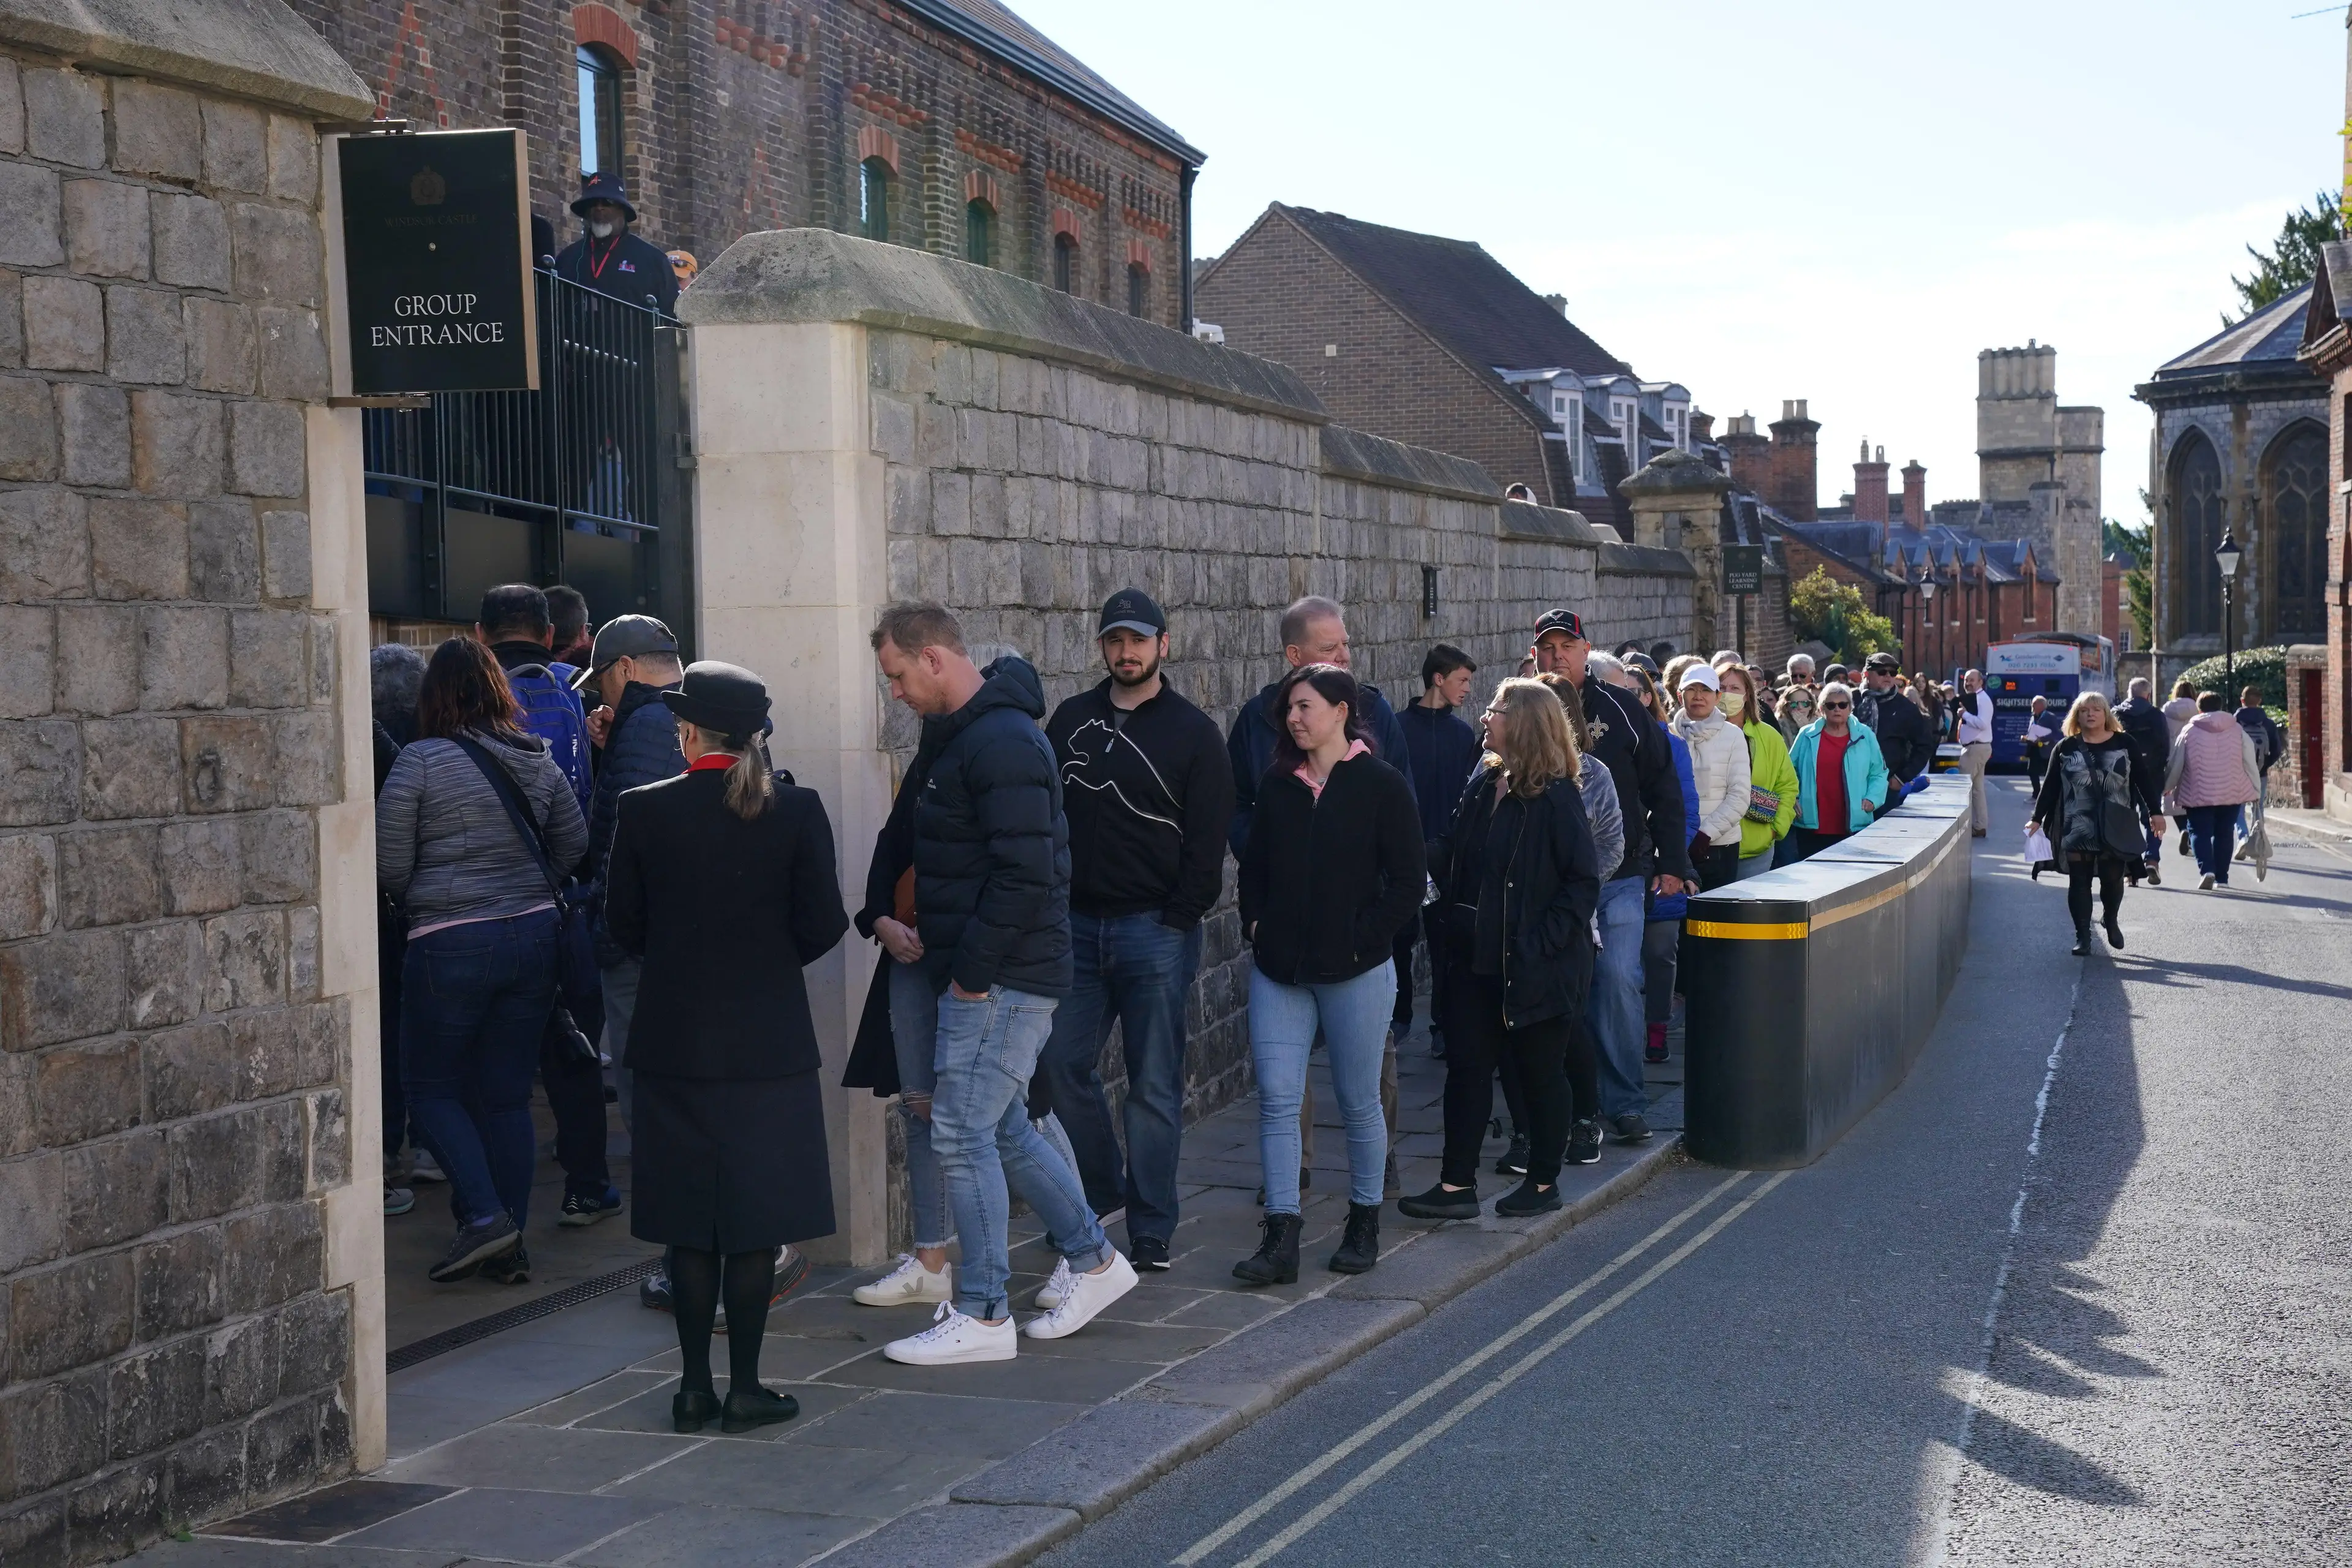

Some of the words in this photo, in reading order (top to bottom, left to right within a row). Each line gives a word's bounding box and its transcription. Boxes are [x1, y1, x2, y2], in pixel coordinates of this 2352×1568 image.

[384, 215, 435, 227] WINDSOR
[437, 213, 478, 225] CASTLE
[394, 293, 477, 316] GROUP
[371, 322, 504, 347] ENTRANCE
[1996, 698, 2032, 707] SIGHTSEEI
[2047, 698, 2067, 707] OURS
